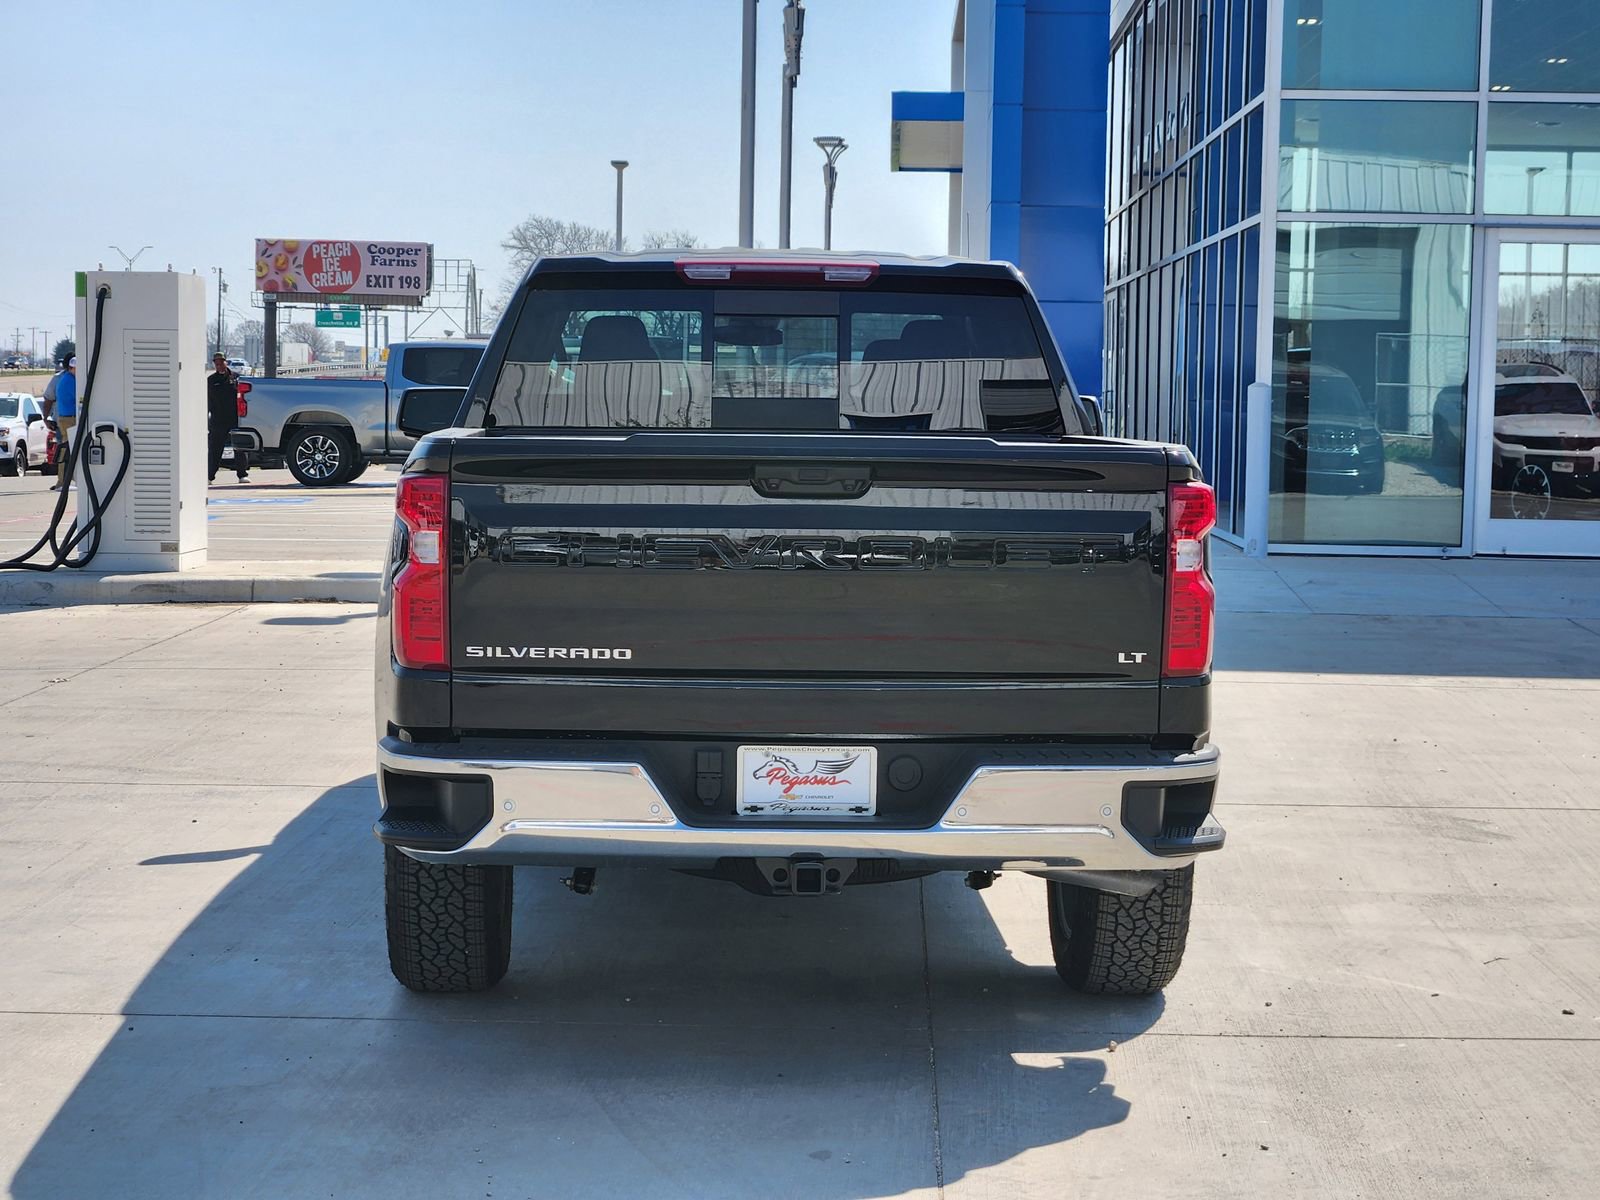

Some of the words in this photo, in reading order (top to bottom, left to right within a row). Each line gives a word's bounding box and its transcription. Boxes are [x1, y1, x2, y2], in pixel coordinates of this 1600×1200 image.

[312, 242, 351, 258] PEACH
[367, 244, 422, 257] Cooper
[322, 257, 341, 272] ICE
[370, 255, 418, 268] Farms
[312, 271, 353, 287] CREAM
[366, 275, 395, 289] EXIT
[398, 276, 421, 289] 198
[499, 533, 1126, 571] CHEVROLET
[465, 645, 633, 661] SILVERADO
[1118, 652, 1147, 664] LT
[766, 767, 851, 794] Pegasus
[770, 802, 843, 814] Pegasus
